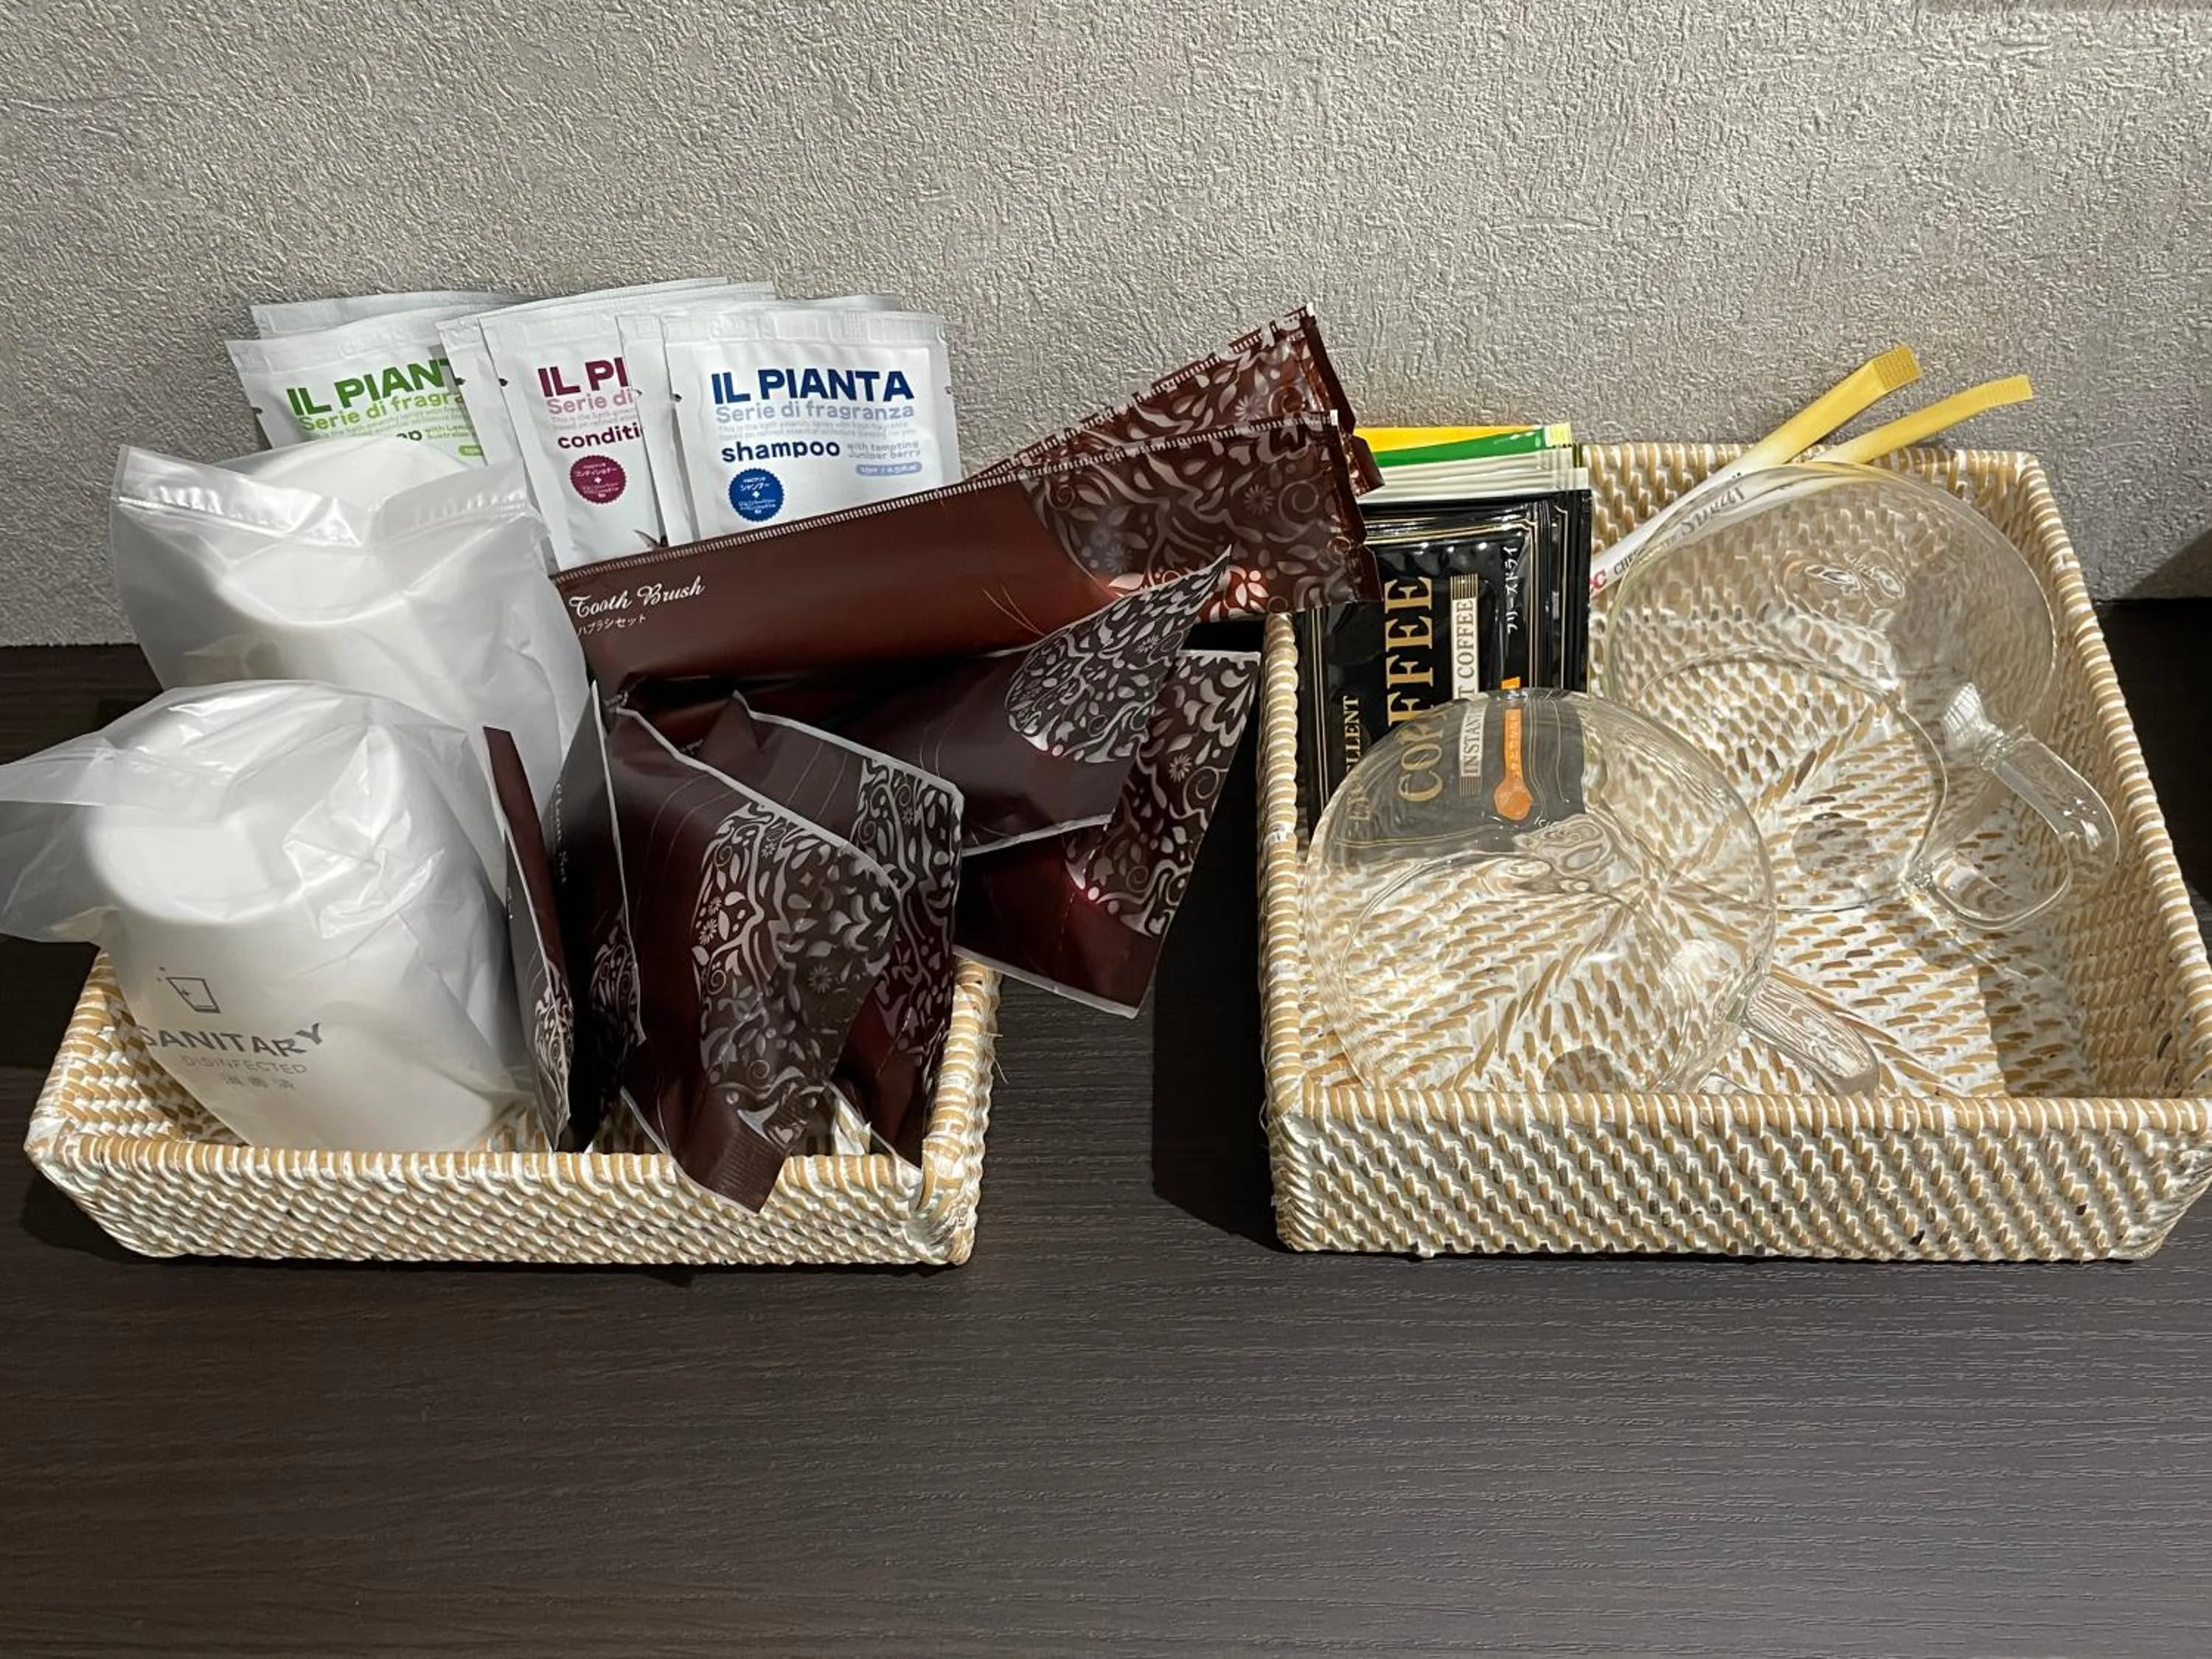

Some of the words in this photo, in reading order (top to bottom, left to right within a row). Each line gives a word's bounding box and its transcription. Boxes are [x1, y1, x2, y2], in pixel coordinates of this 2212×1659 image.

[538, 366, 581, 397] IL
[585, 357, 629, 391] PI
[712, 373, 751, 404] IL
[758, 369, 914, 402] PIANTA
[287, 387, 332, 416] IL
[299, 410, 360, 431] Serie
[366, 400, 387, 419] di
[546, 394, 608, 414] Serie
[613, 389, 633, 406] di
[715, 403, 775, 423] Serie
[781, 401, 801, 419] di
[806, 400, 914, 420] fragranza
[557, 422, 641, 449] conditi
[722, 440, 841, 462] shampoo
[568, 590, 633, 619] Tooth
[636, 574, 706, 607] Brush
[1502, 546, 1519, 635] フリーズドライ
[1455, 599, 1475, 679] COFFEE
[136, 1022, 323, 1058] SANITARY
